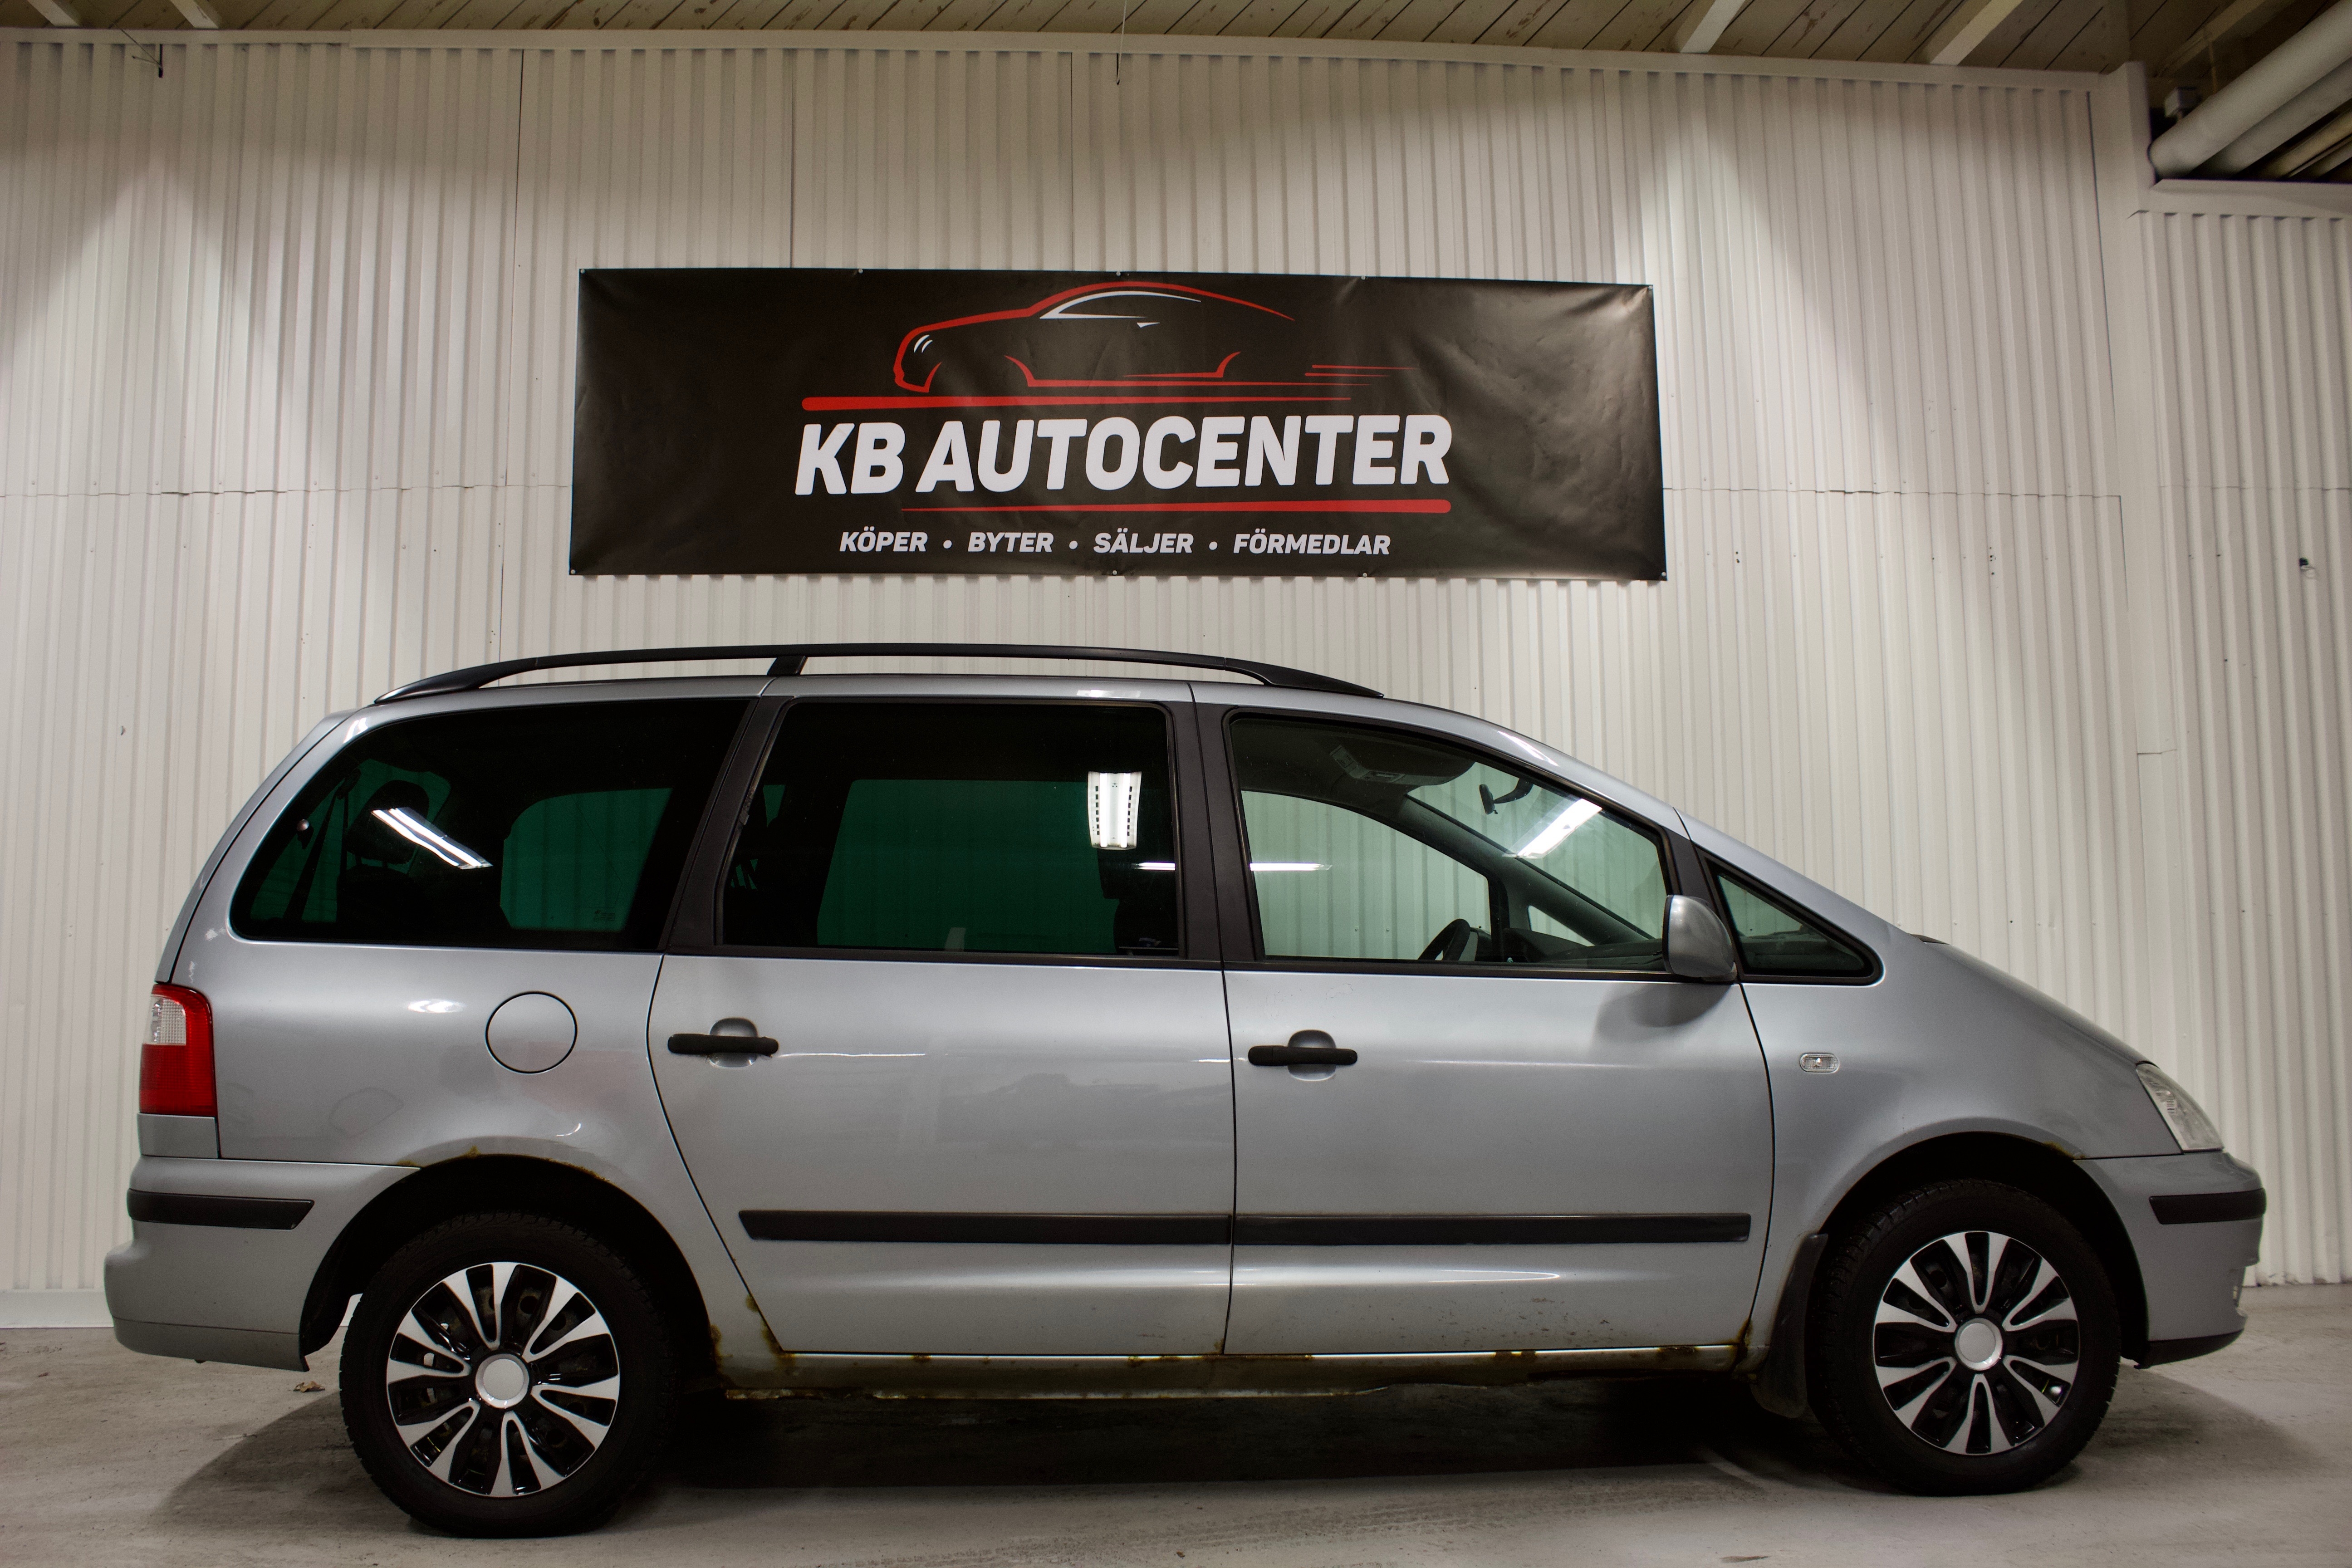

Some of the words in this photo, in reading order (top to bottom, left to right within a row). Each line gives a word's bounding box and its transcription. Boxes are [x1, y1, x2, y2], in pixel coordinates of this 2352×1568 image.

[794, 421, 906, 495] KB
[915, 413, 1453, 493] AUTOCENTER
[839, 526, 928, 553] KÖPER
[967, 531, 1054, 553] BYTER
[1093, 527, 1194, 554] SÄLJER
[1233, 528, 1391, 555] FÖRMEDLAR
